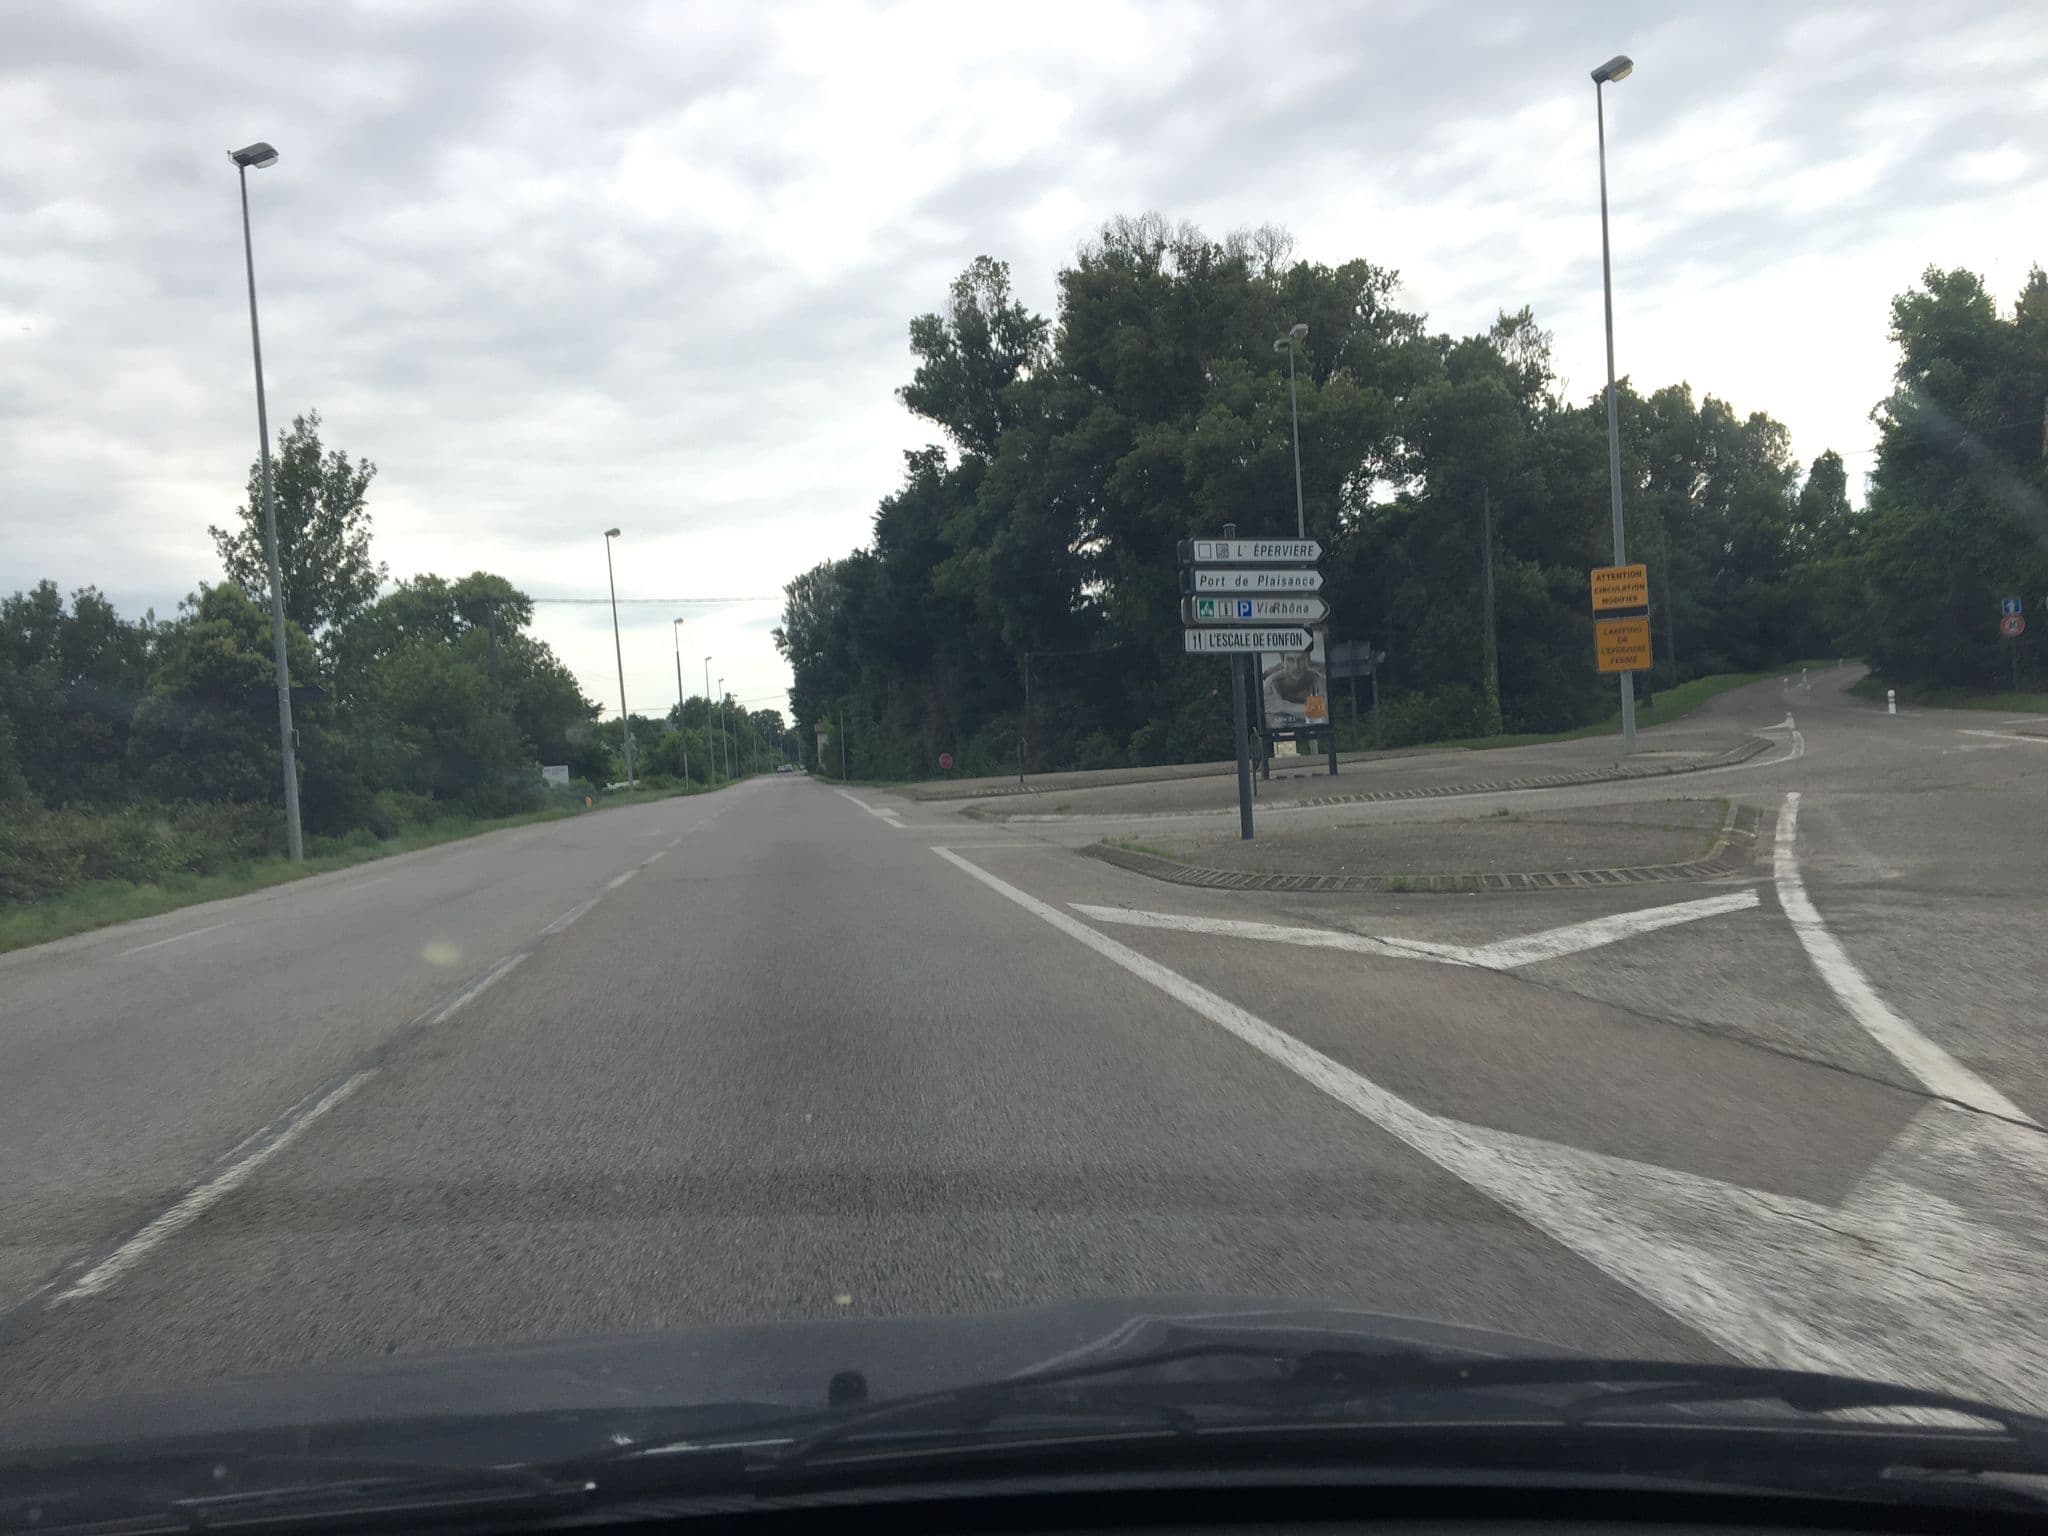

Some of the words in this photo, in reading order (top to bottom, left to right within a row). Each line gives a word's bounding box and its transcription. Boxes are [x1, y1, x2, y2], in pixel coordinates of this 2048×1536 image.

[1199, 575, 1225, 588] Port
[1235, 575, 1249, 588] de
[1257, 575, 1315, 588] Plaisance
[1596, 570, 1642, 582] ATTENTION
[1240, 602, 1250, 615] P
[1209, 632, 1251, 648] L'ESCALE
[1253, 632, 1265, 647] DE
[1267, 632, 1303, 647] FONFON
